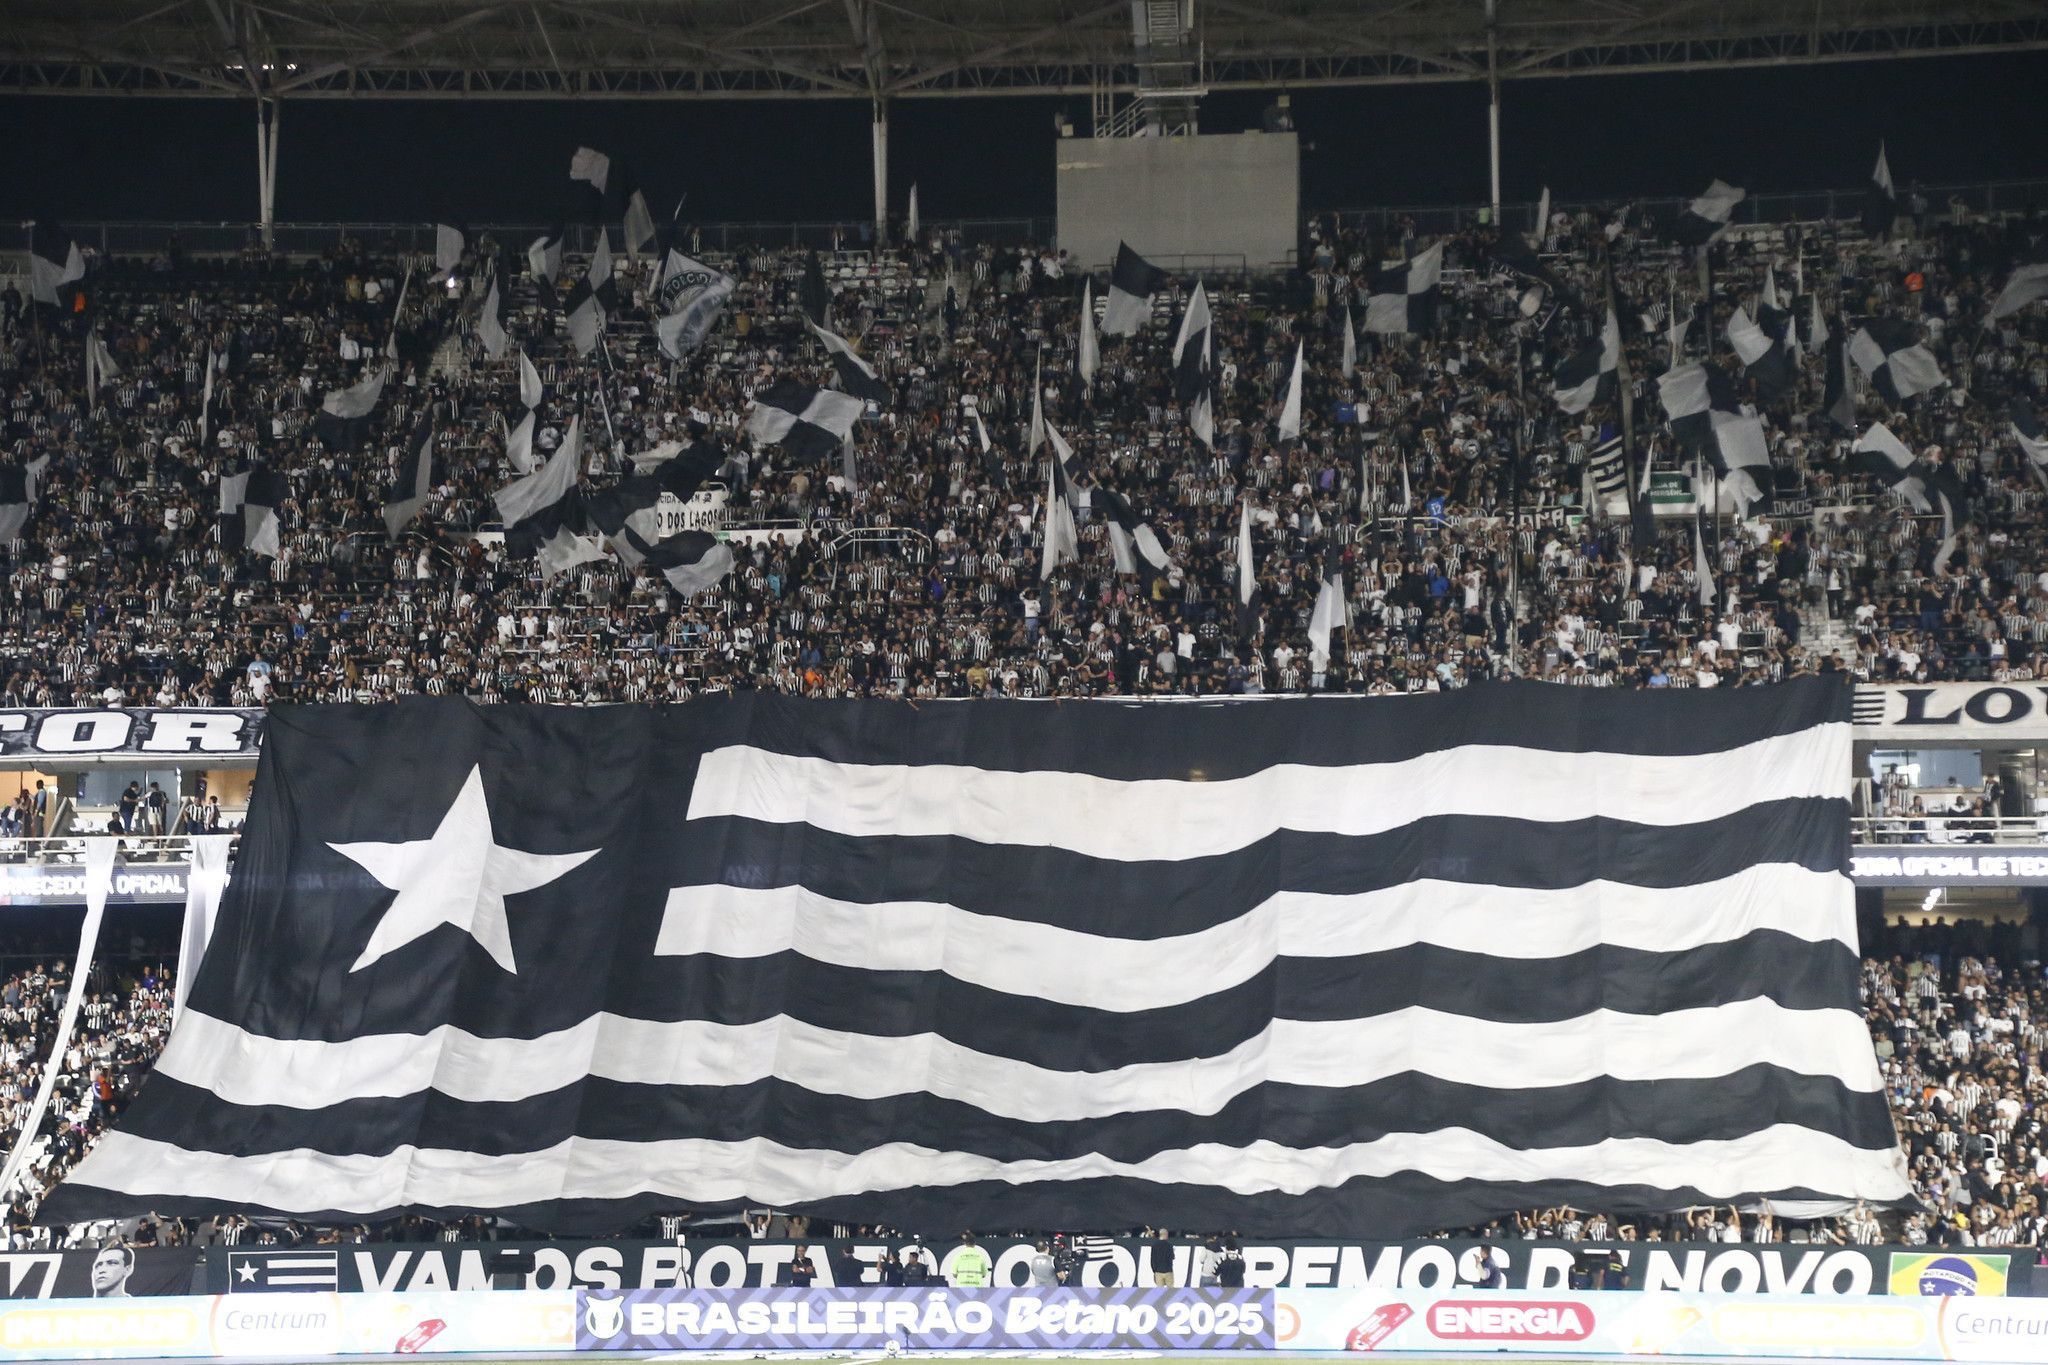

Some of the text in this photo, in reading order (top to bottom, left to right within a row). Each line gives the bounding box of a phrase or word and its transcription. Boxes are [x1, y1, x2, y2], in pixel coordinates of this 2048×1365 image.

[1773, 499, 1813, 516] OMOS
[667, 511, 685, 529] DOS
[1892, 687, 2048, 725] LO
[1979, 857, 2008, 876] DE
[116, 874, 186, 895] OFICIAL
[1643, 1249, 1874, 1295] NOVO
[225, 1310, 328, 1330] Centrum
[630, 1292, 993, 1335] BRASILEIRÃO
[1004, 1297, 1158, 1334] Betano
[1165, 1302, 1264, 1335] 2025
[1435, 1306, 1585, 1335] ENERGIA
[1955, 1312, 2048, 1335] Centru
